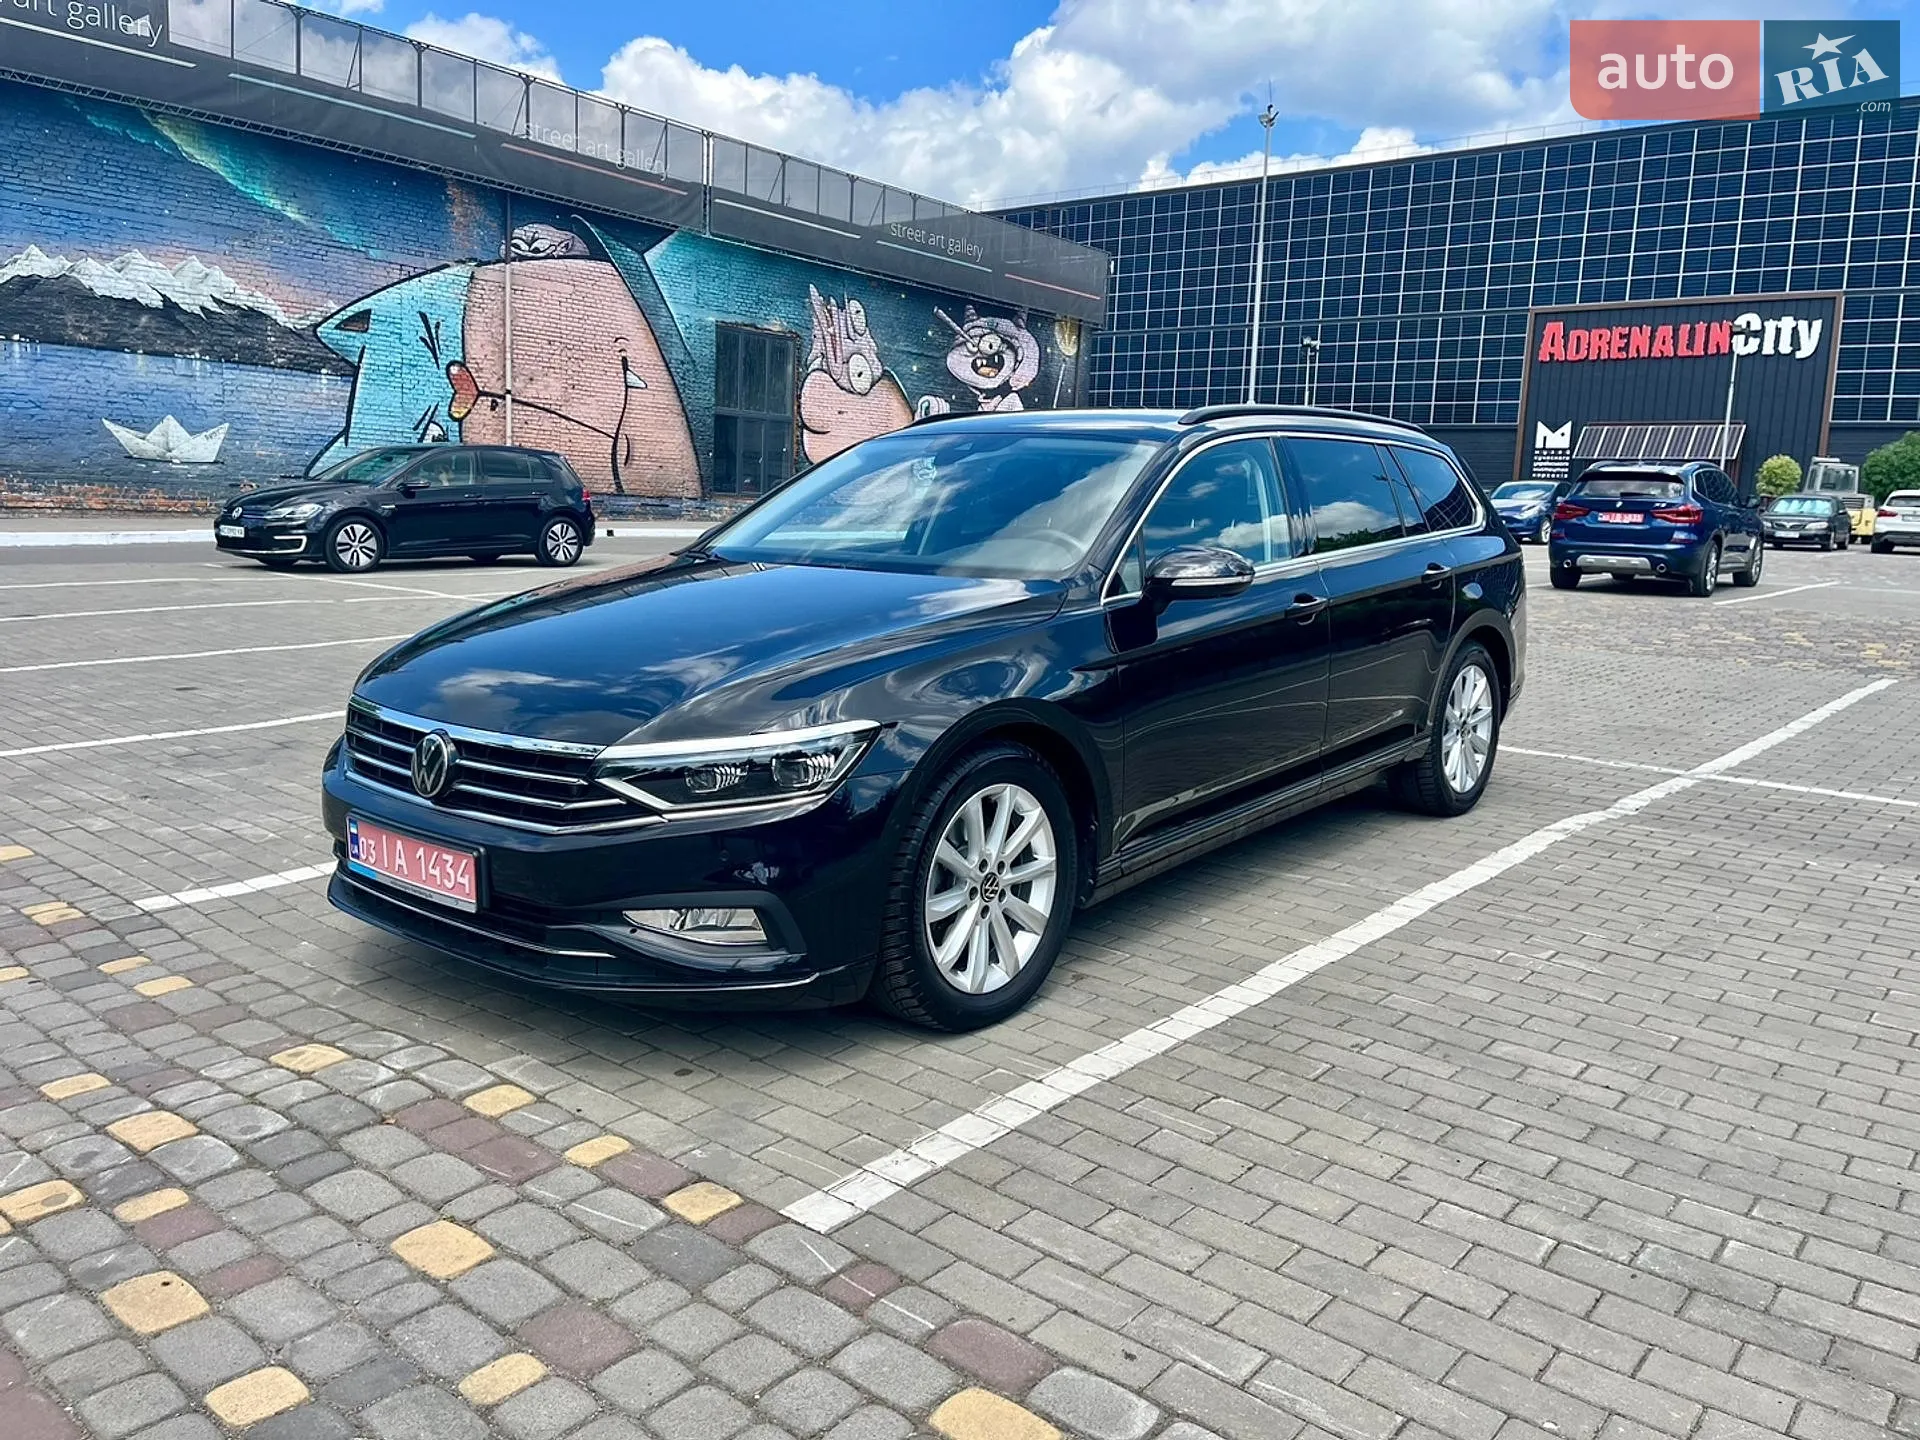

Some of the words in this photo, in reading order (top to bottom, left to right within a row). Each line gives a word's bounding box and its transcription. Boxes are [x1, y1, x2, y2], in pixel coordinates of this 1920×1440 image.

[66, 0, 163, 48] gallery
[523, 122, 580, 154] street
[585, 139, 609, 161] art
[890, 222, 926, 245] street
[928, 232, 945, 249] art
[947, 237, 984, 263] gallery
[359, 836, 376, 864] 03
[382, 834, 408, 875] IA
[416, 847, 471, 894] 1434
